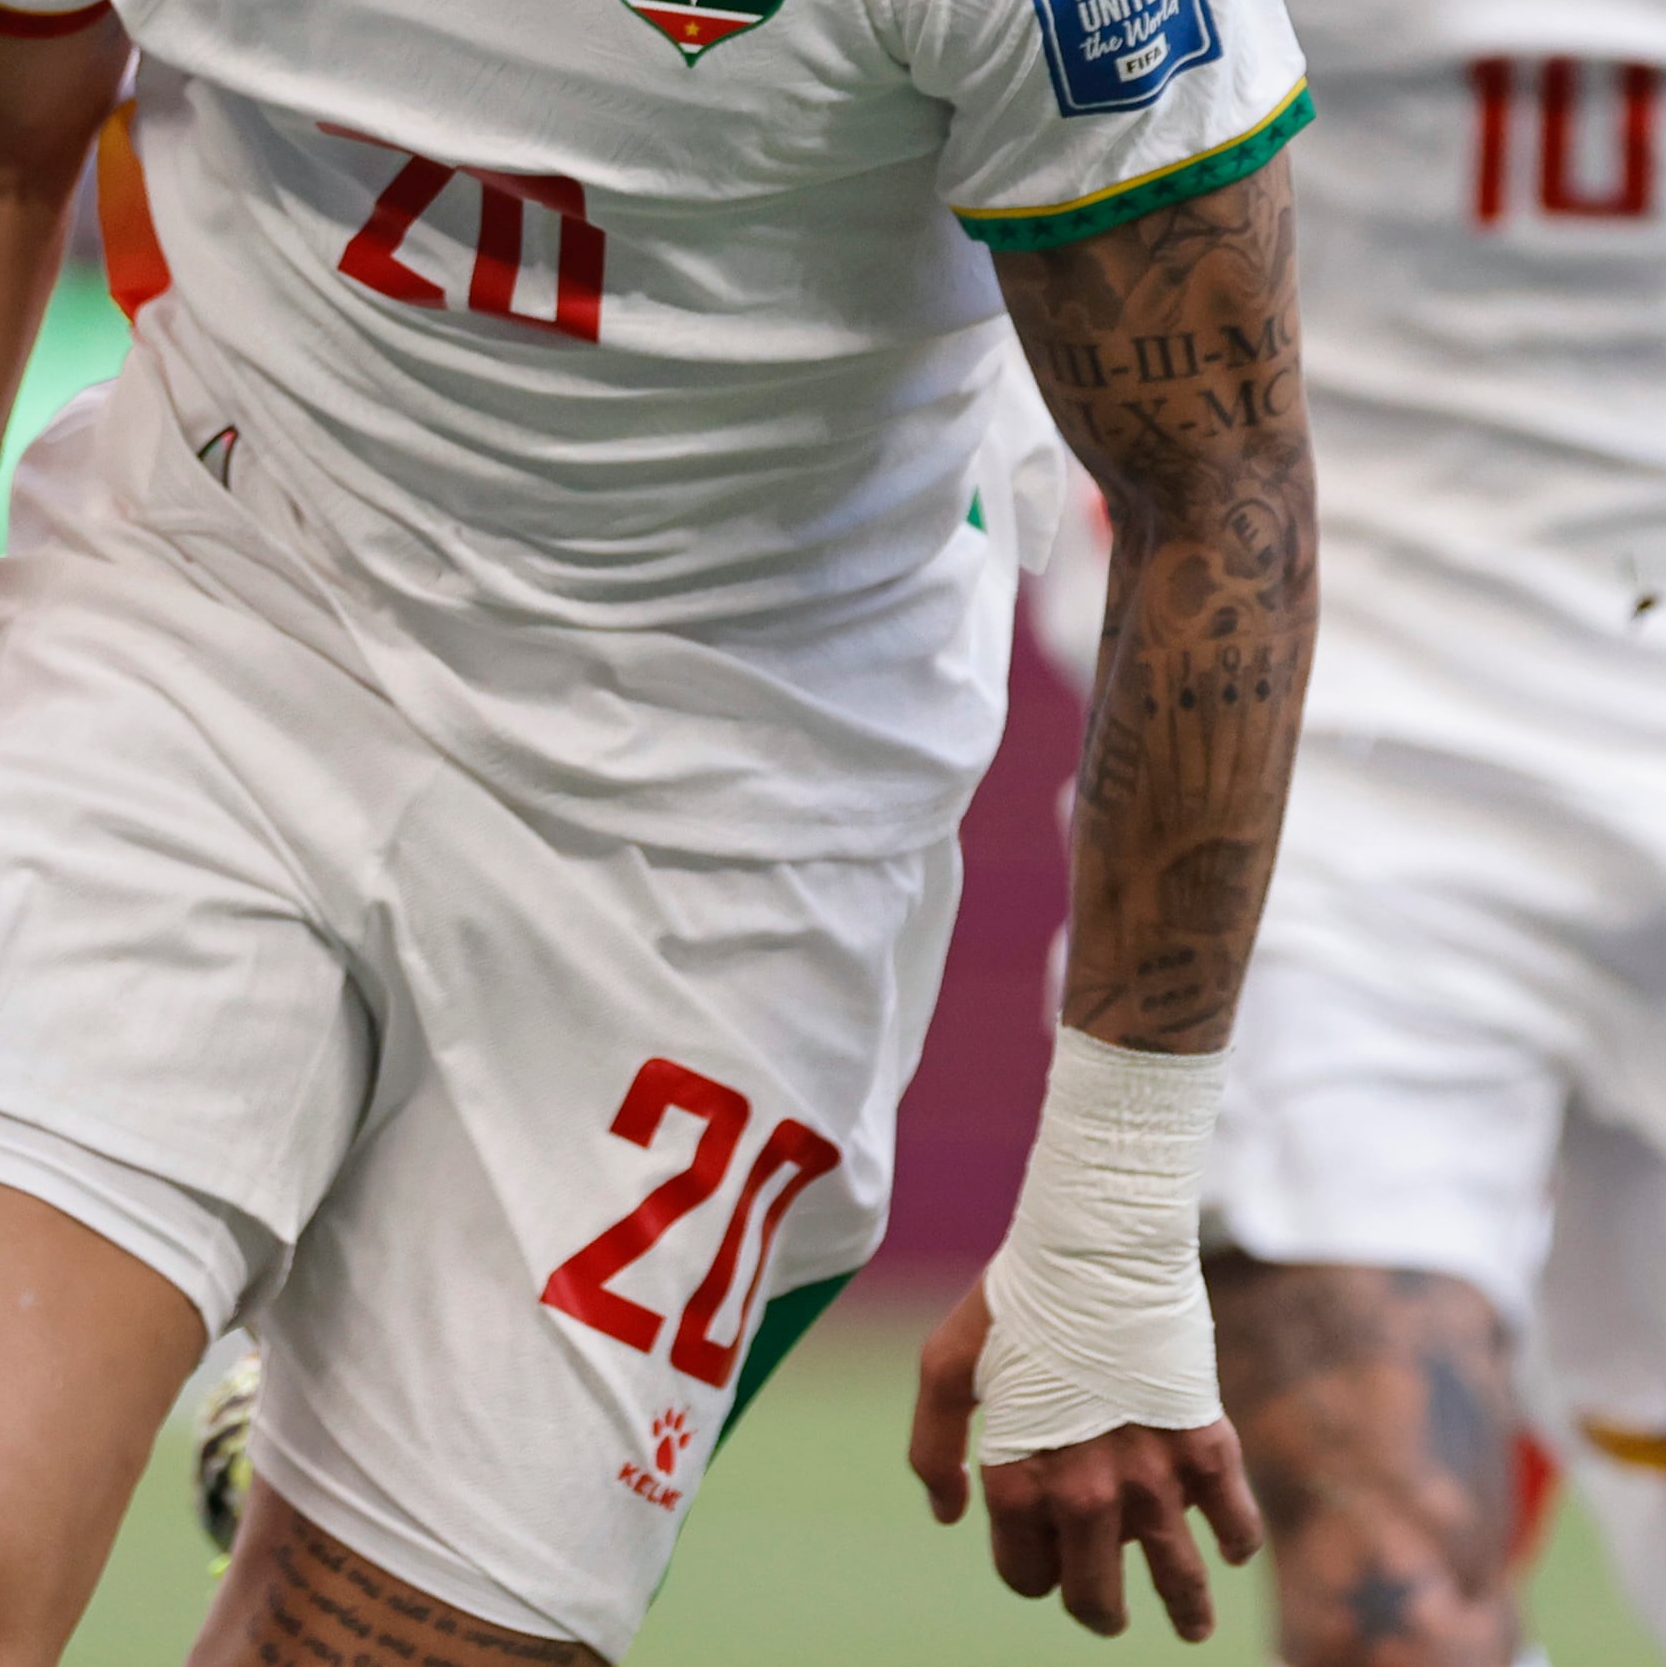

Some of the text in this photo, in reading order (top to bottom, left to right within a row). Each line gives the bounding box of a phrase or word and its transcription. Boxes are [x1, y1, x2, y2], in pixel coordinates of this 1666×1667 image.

[1079, 27, 1123, 62] the
[1126, 45, 1163, 76] FIFA
[1466, 54, 1666, 227] 10
[316, 121, 606, 345] 20
[539, 1056, 843, 1390] 20
